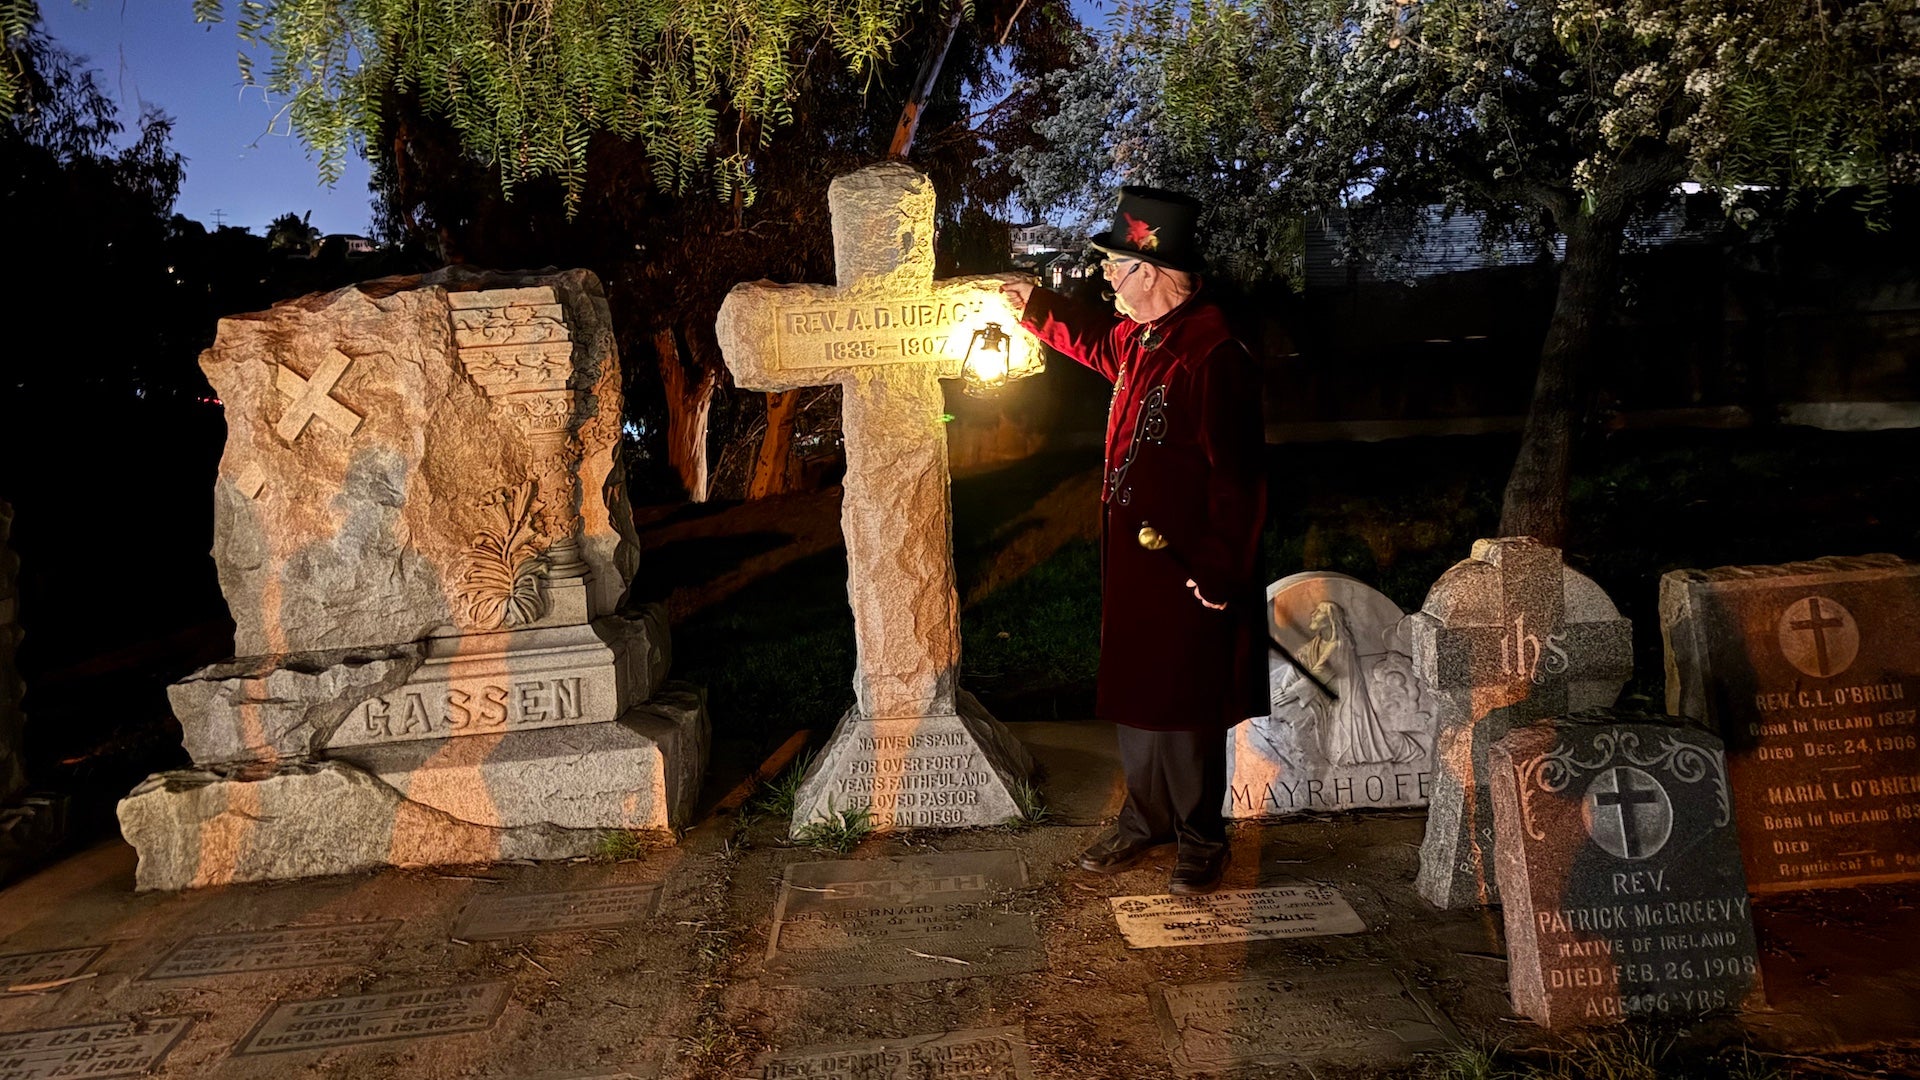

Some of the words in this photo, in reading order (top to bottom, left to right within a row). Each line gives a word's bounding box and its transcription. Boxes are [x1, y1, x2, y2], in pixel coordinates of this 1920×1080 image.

[365, 677, 583, 737] GASSEN
[1757, 691, 1795, 711] REV.
[1878, 710, 1916, 727] 1827
[857, 736, 904, 751] NATIVE
[907, 736, 922, 748] OF
[850, 760, 878, 775] FOR
[883, 758, 919, 773] OVER
[924, 754, 972, 771] FORTY
[837, 776, 885, 793] YEARS
[888, 772, 958, 791] FAITHFUL
[960, 770, 988, 787] AND
[1231, 771, 1431, 811] MAYRHOFE
[848, 794, 915, 811] BELOVED
[919, 790, 977, 807] PASTOR
[1769, 784, 1827, 805] MARIA
[884, 812, 914, 828] SAN
[919, 809, 967, 825] DIEGO.
[1611, 870, 1671, 896] REV.
[843, 905, 934, 918] BERNARD
[1538, 906, 1628, 934] PATRICK
[1635, 896, 1748, 926] McGREEVY
[1559, 939, 1625, 957] NATIVE
[1632, 937, 1652, 952] OF
[1660, 931, 1737, 950] IRELAND
[1551, 967, 1602, 988] DIED
[1613, 961, 1661, 983] FEB.
[1704, 953, 1757, 978] 1908
[1680, 989, 1733, 1011] YRS.
